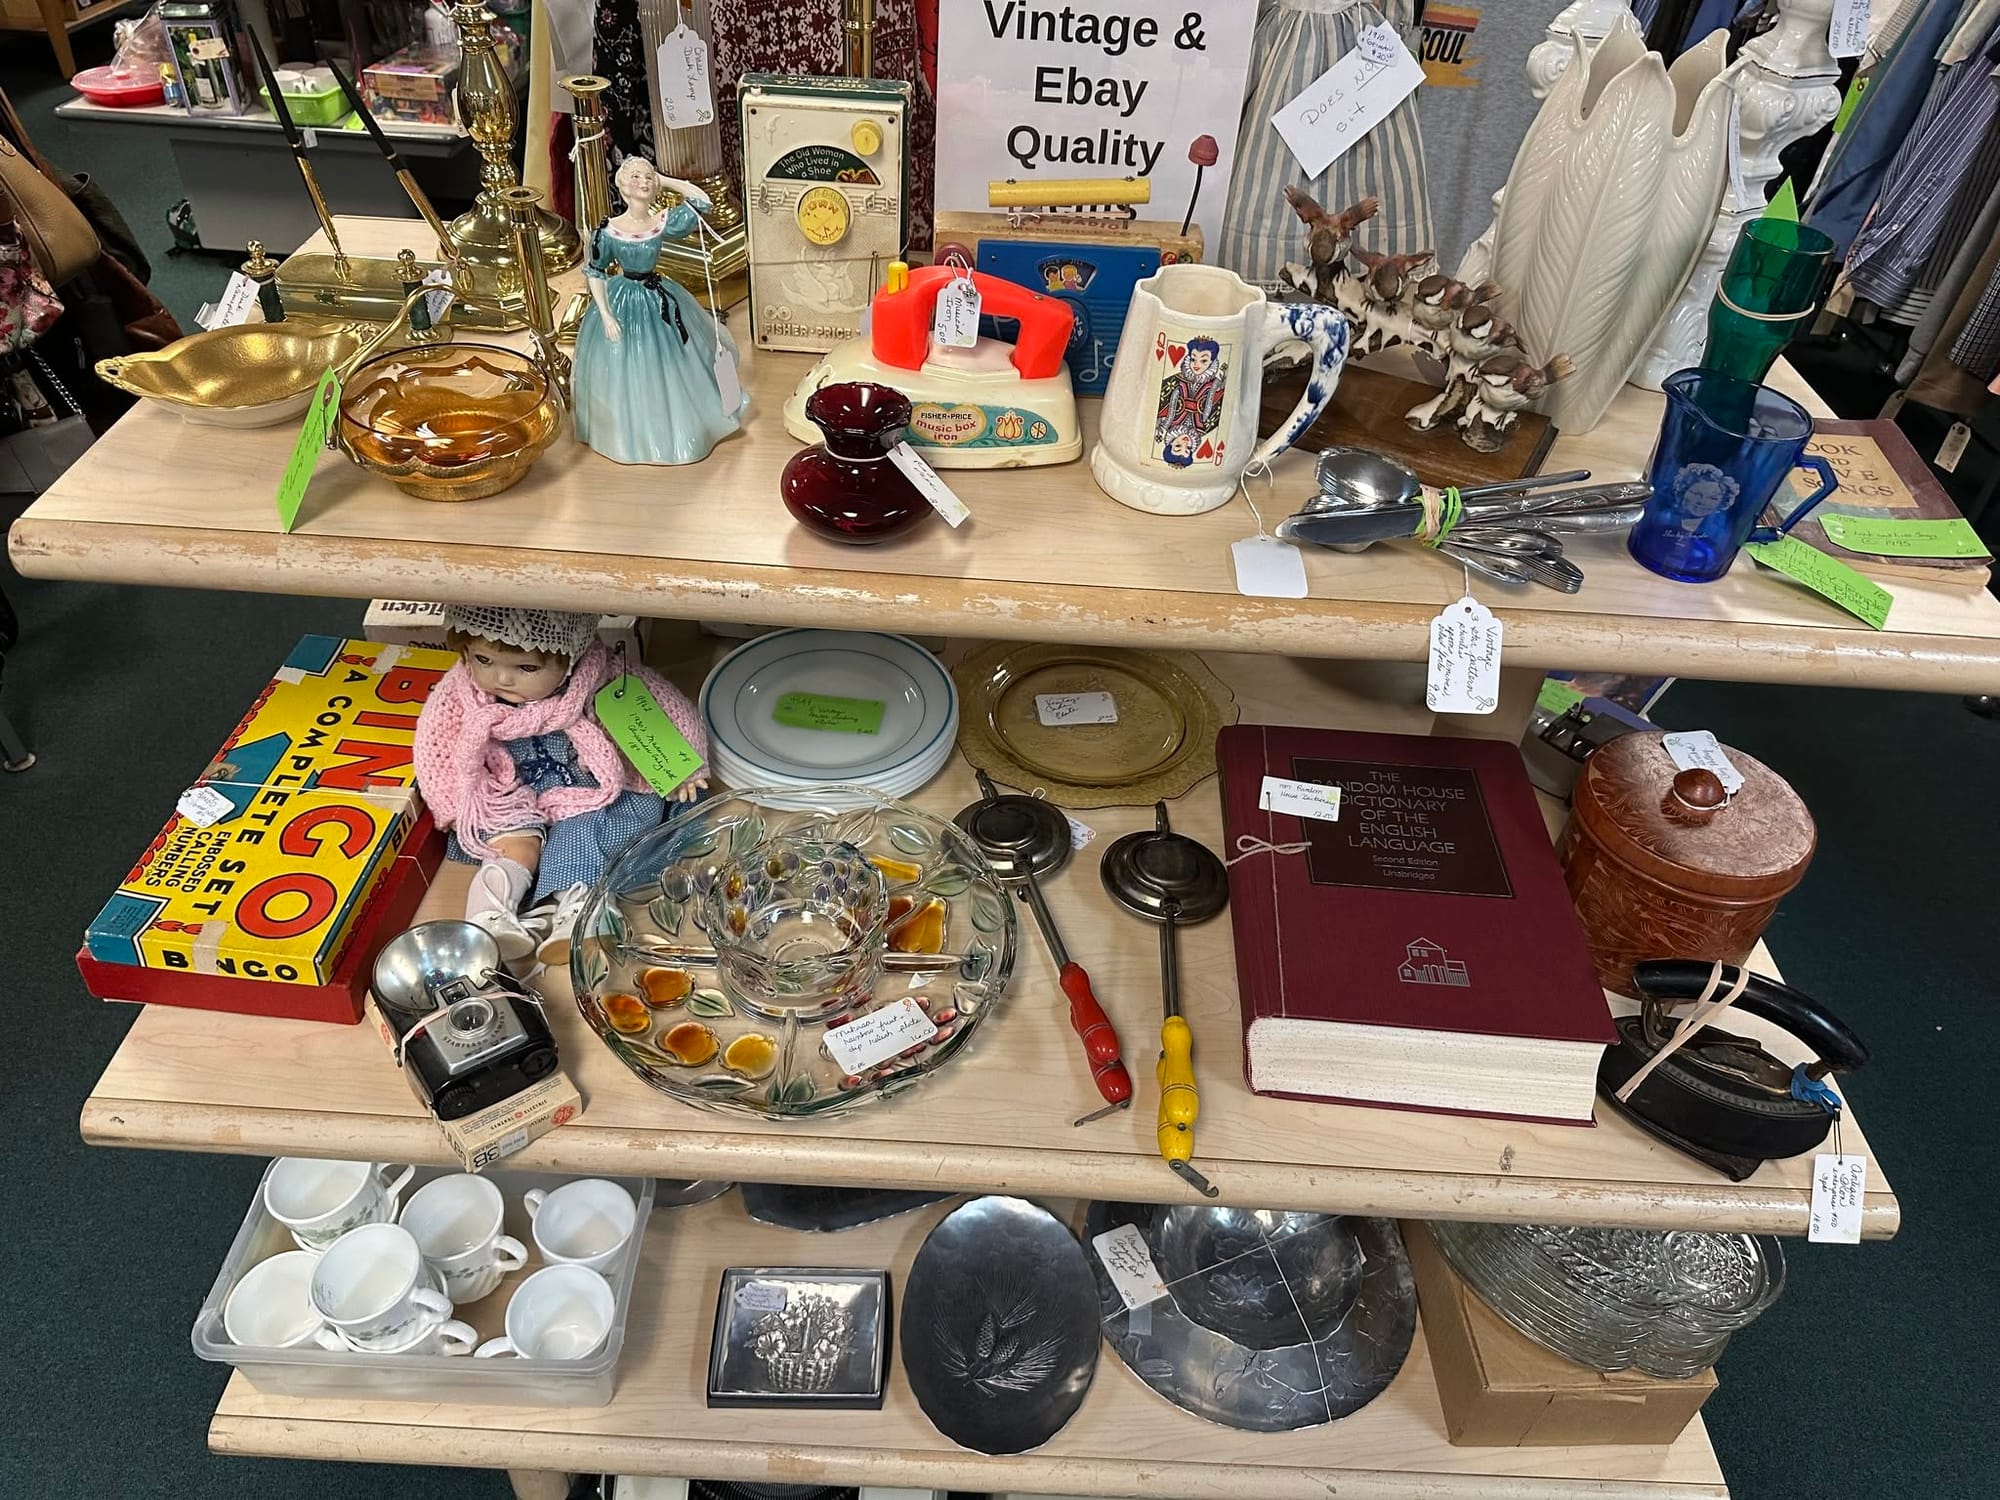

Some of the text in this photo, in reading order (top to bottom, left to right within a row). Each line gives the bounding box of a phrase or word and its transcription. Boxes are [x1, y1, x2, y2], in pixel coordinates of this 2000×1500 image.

[985, 0, 1206, 56] Vintage &
[1421, 28, 1467, 65] SOUL
[1034, 66, 1149, 117] Ebay
[1300, 88, 1344, 126] DOES
[779, 146, 845, 168] The Old Woman
[1007, 125, 1165, 177] Quality
[785, 157, 840, 175] Who Lived in
[807, 166, 832, 176] Shoe
[1157, 331, 1166, 350] Q
[916, 419, 977, 433] music box
[933, 433, 958, 441] iron
[1806, 441, 1864, 456] OOK
[1802, 477, 1894, 497] SNGS
[1478, 626, 1498, 672] Vintage
[343, 669, 369, 683] A
[236, 695, 353, 845] COMPLETE
[1369, 771, 1401, 782] THE
[1312, 779, 1466, 800] NDOM HOUSE
[1341, 794, 1447, 812] DICTIONARY
[1360, 809, 1429, 824] OF THE
[1359, 822, 1438, 839] ENGLISH
[1348, 835, 1457, 855] LANGUAGE
[145, 826, 199, 887] NUMBERS
[165, 831, 213, 887] CALLING
[181, 831, 232, 893] EMBOSSED
[1373, 855, 1439, 866] Second Edition
[1383, 869, 1436, 880] Unabridged
[192, 858, 247, 916] SET
[162, 949, 298, 981] BNGO
